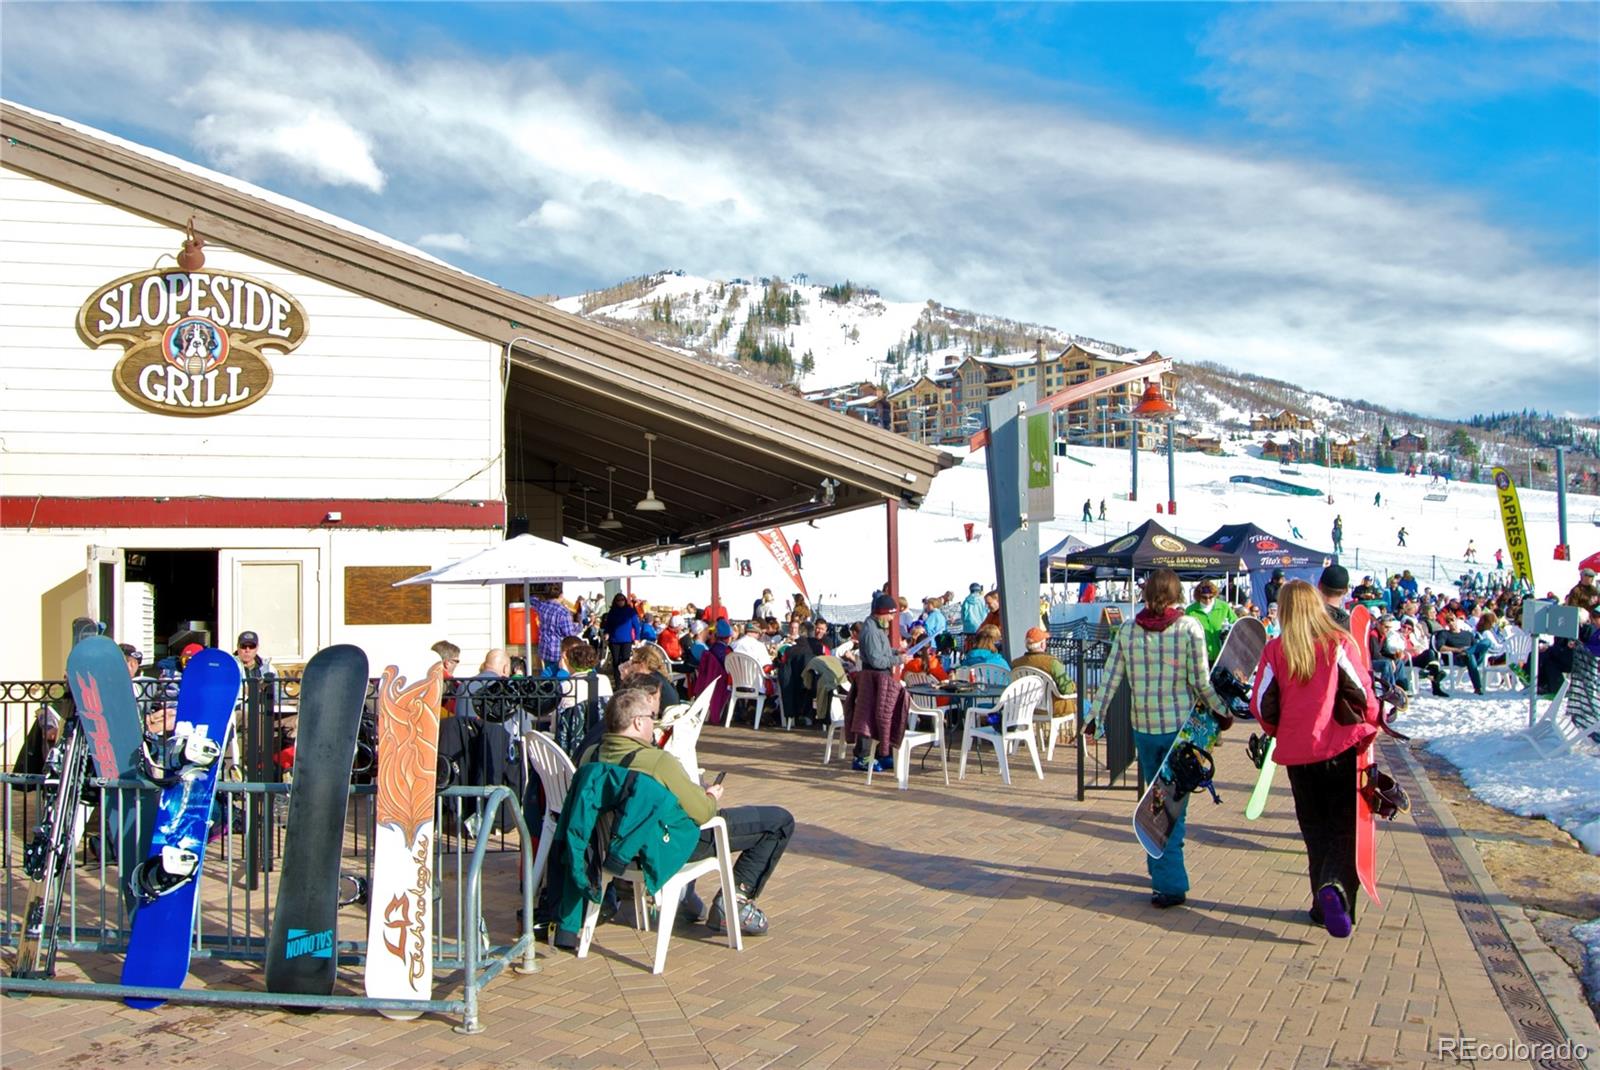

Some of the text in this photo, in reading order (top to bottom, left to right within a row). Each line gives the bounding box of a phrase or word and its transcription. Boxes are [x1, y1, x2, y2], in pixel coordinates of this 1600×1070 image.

[99, 273, 292, 337] SLOPESIDE
[139, 364, 249, 407] GRILL
[1501, 494, 1522, 547] APRÈS
[1260, 556, 1281, 566] Tito's
[408, 833, 431, 993] Technologies
[286, 928, 333, 960] SALOMON
